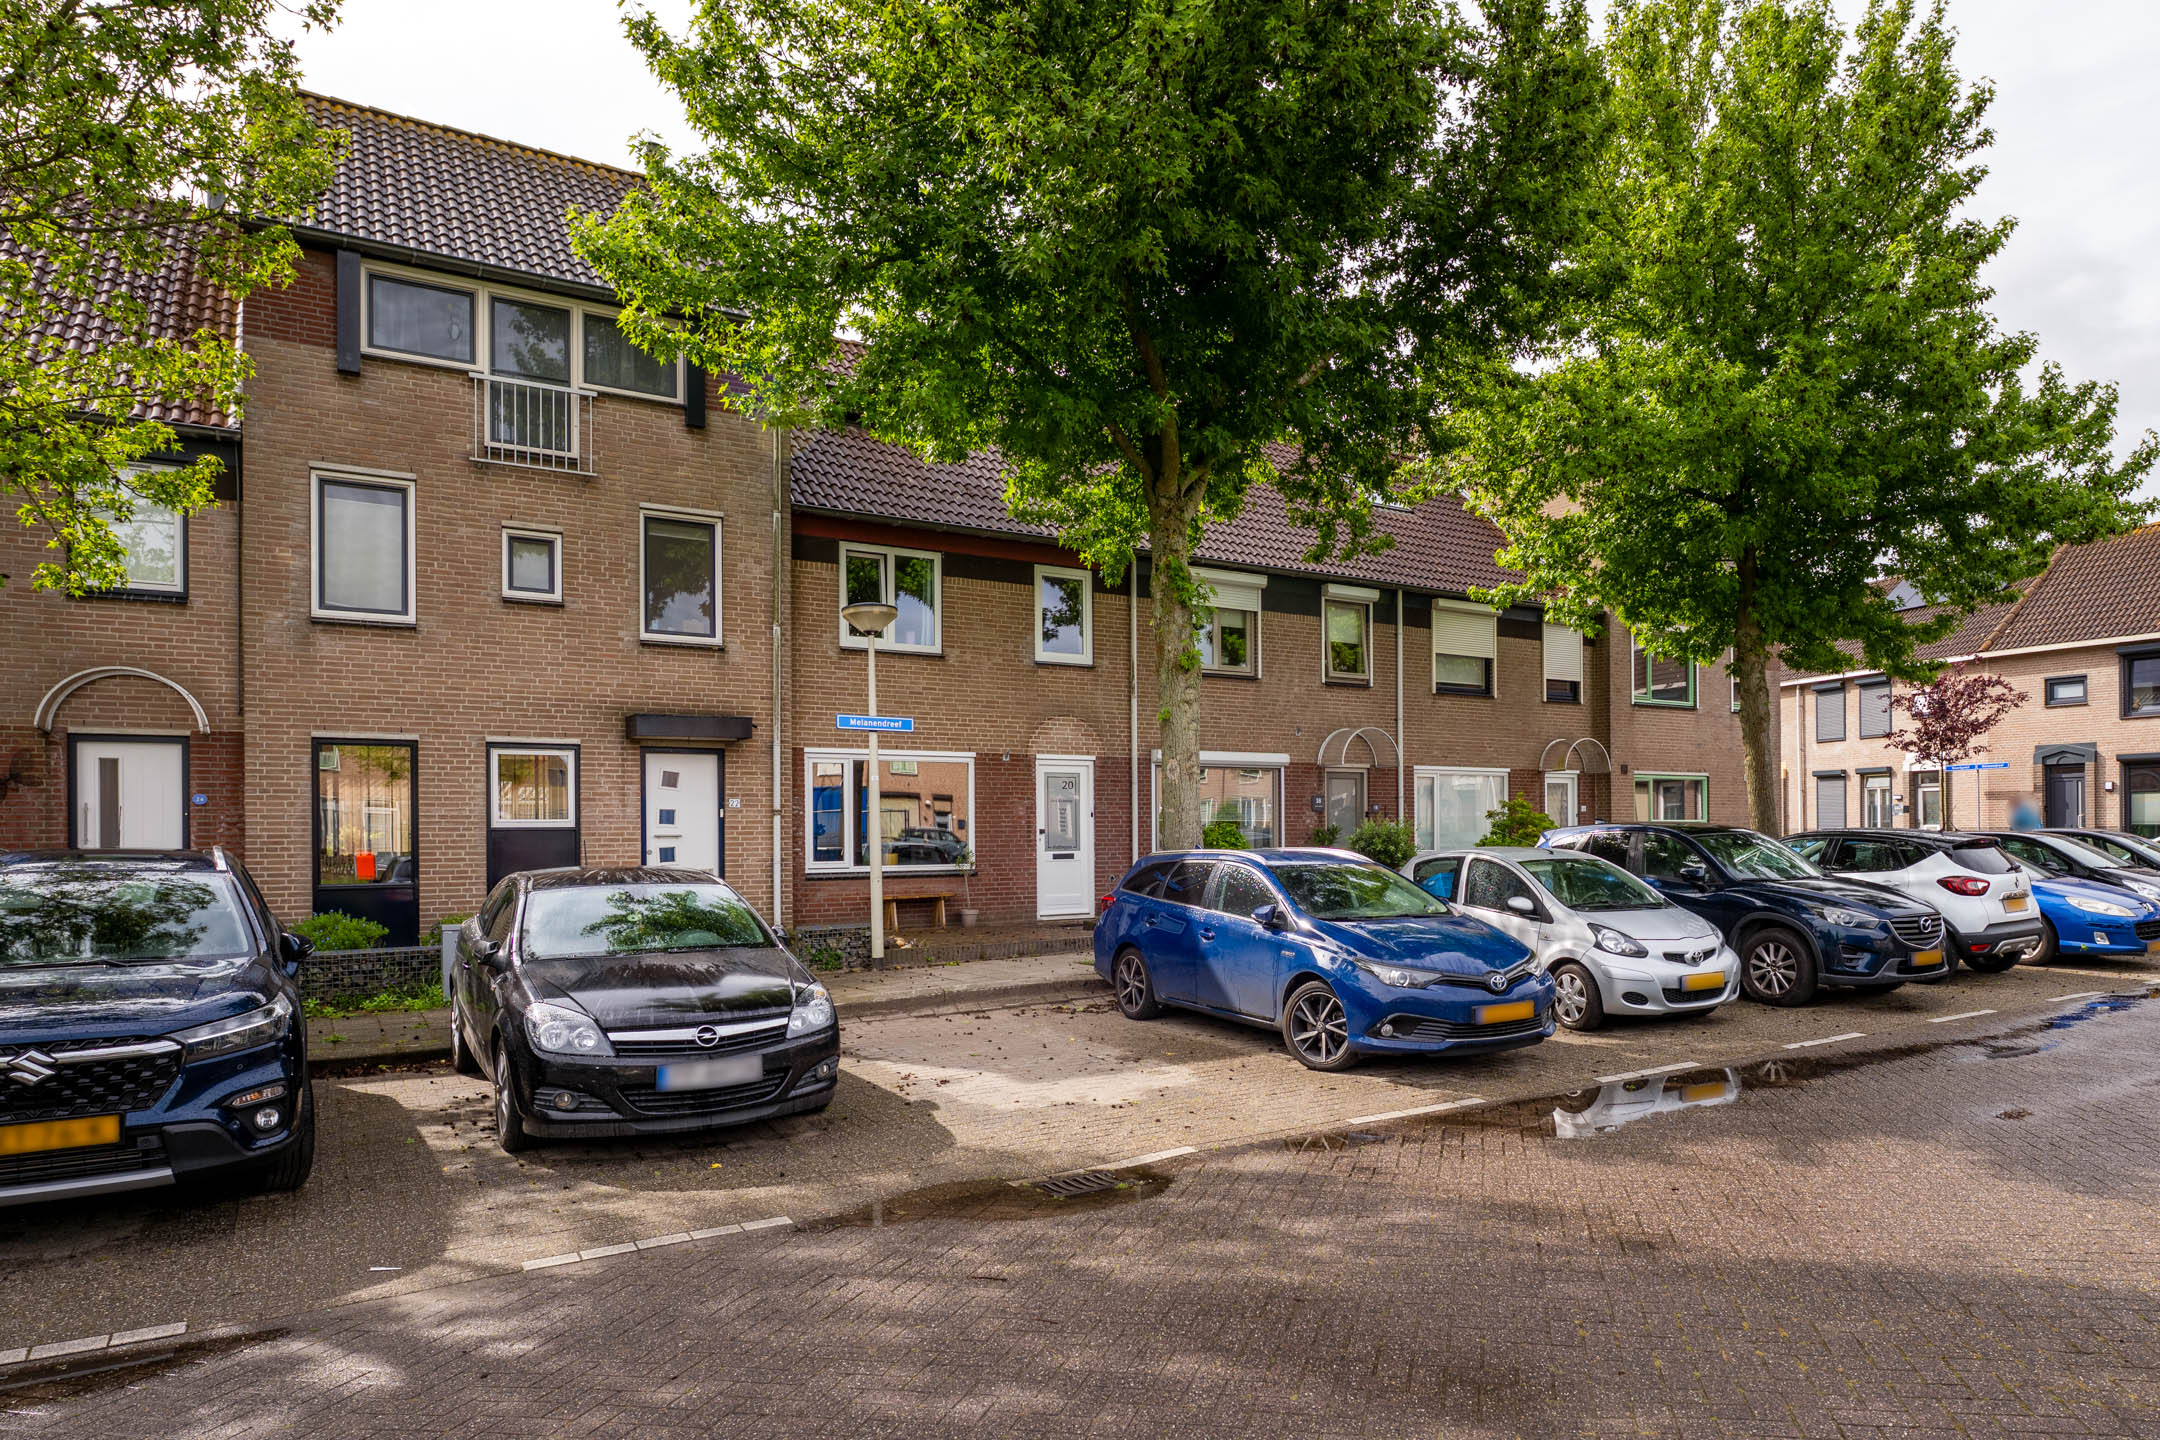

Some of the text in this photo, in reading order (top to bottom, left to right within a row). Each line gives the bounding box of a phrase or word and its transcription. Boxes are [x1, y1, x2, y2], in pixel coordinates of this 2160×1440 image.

[849, 718, 902, 728] Melanendreef
[1062, 780, 1074, 790] 20
[730, 799, 739, 807] 22
